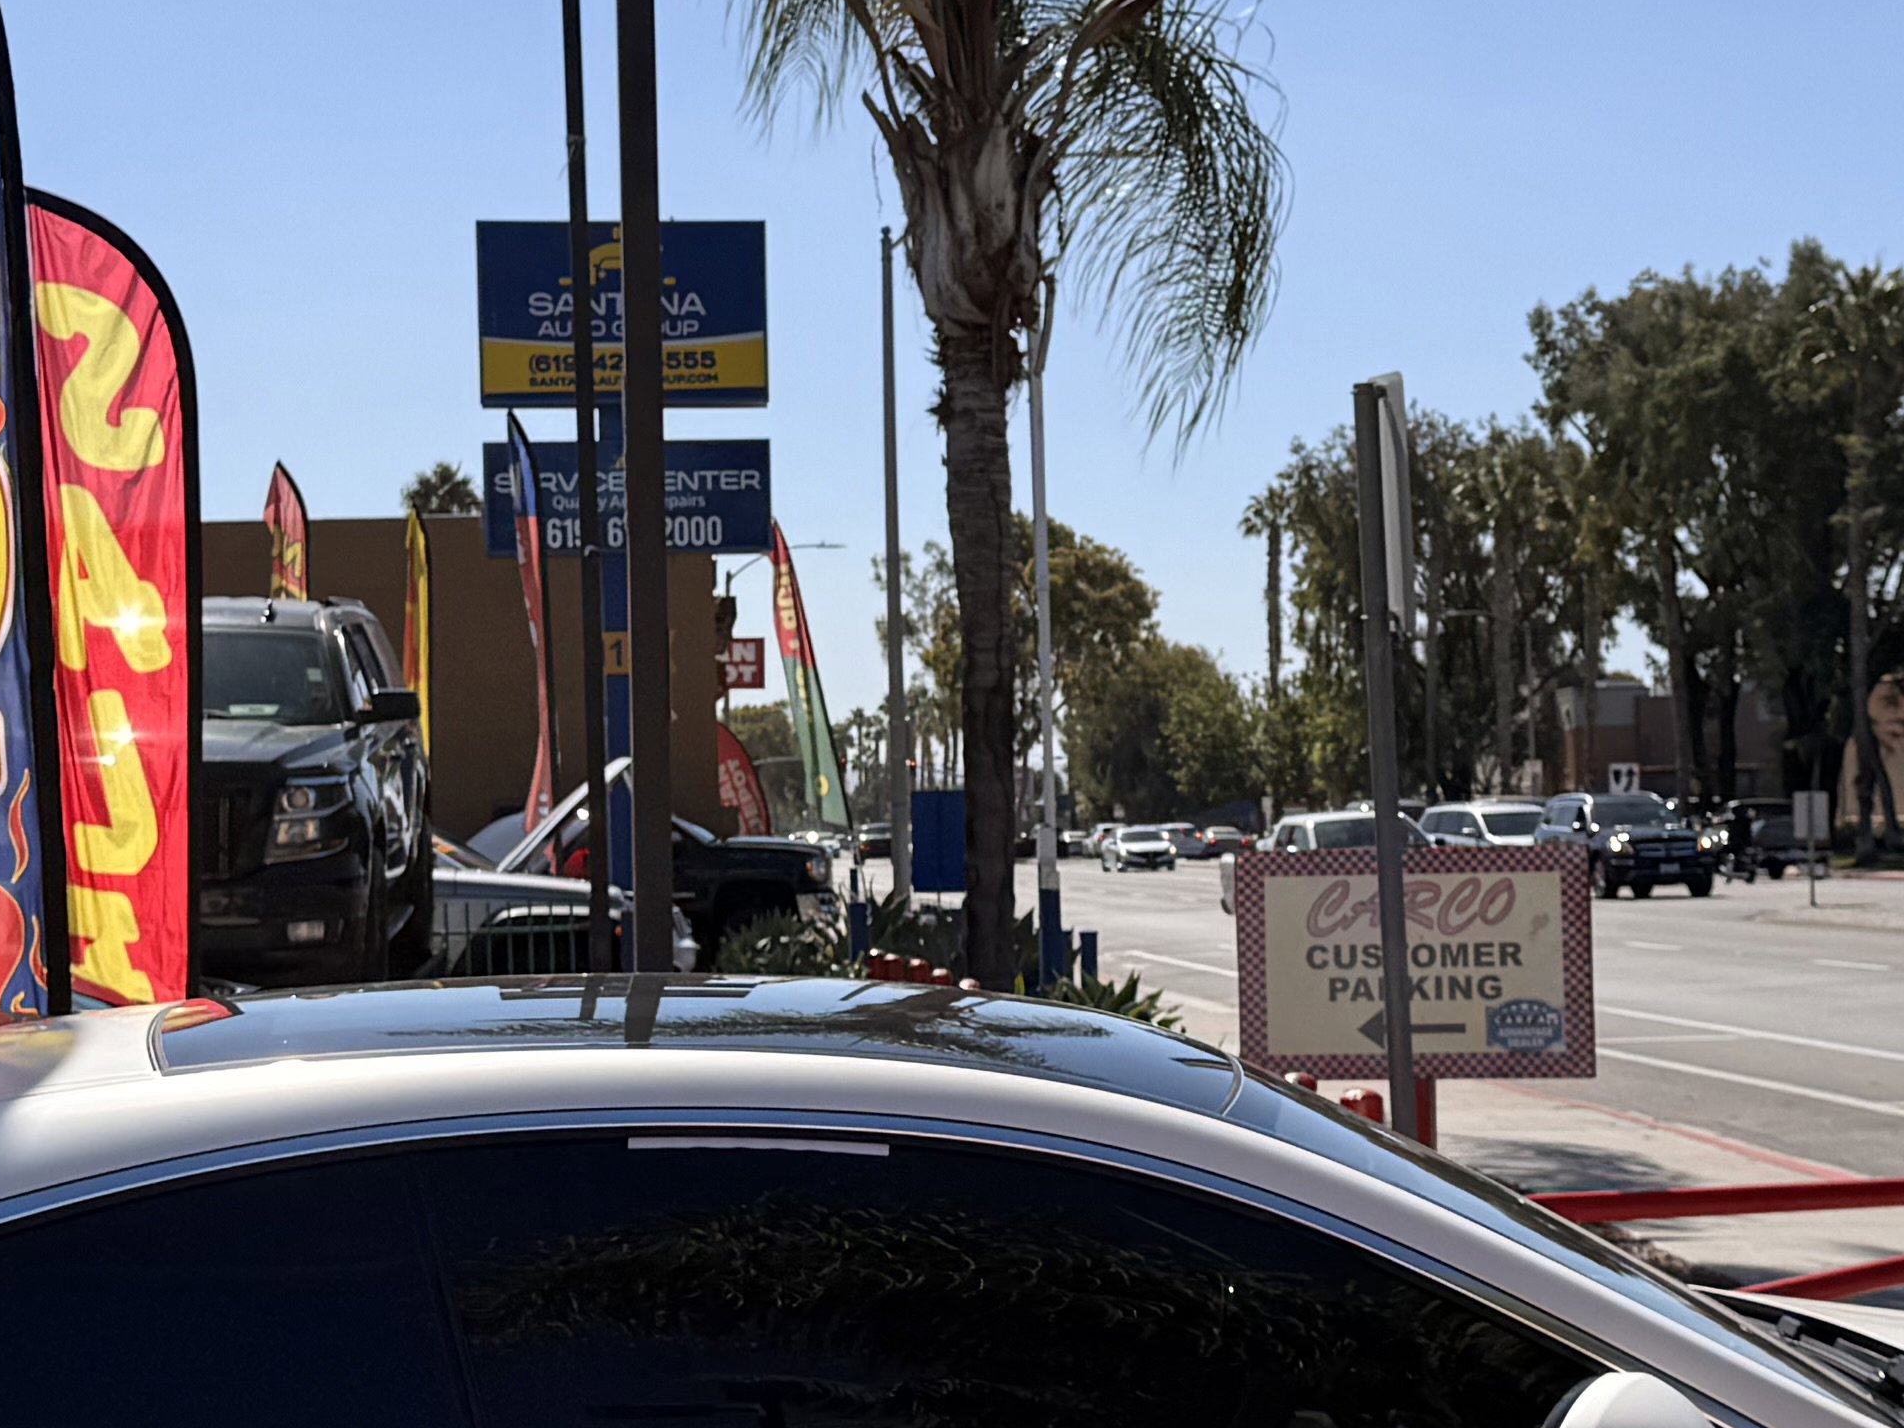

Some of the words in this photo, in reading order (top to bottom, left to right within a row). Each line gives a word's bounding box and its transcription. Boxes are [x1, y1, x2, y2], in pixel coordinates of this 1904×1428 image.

[528, 291, 706, 316] SANTNA
[537, 319, 607, 338] AUO
[611, 319, 699, 337] GUP
[494, 471, 626, 494] SRVCE
[663, 469, 762, 492] ENTER
[1305, 941, 1523, 970] CUSOMER
[1328, 974, 1504, 1002] PAKING
